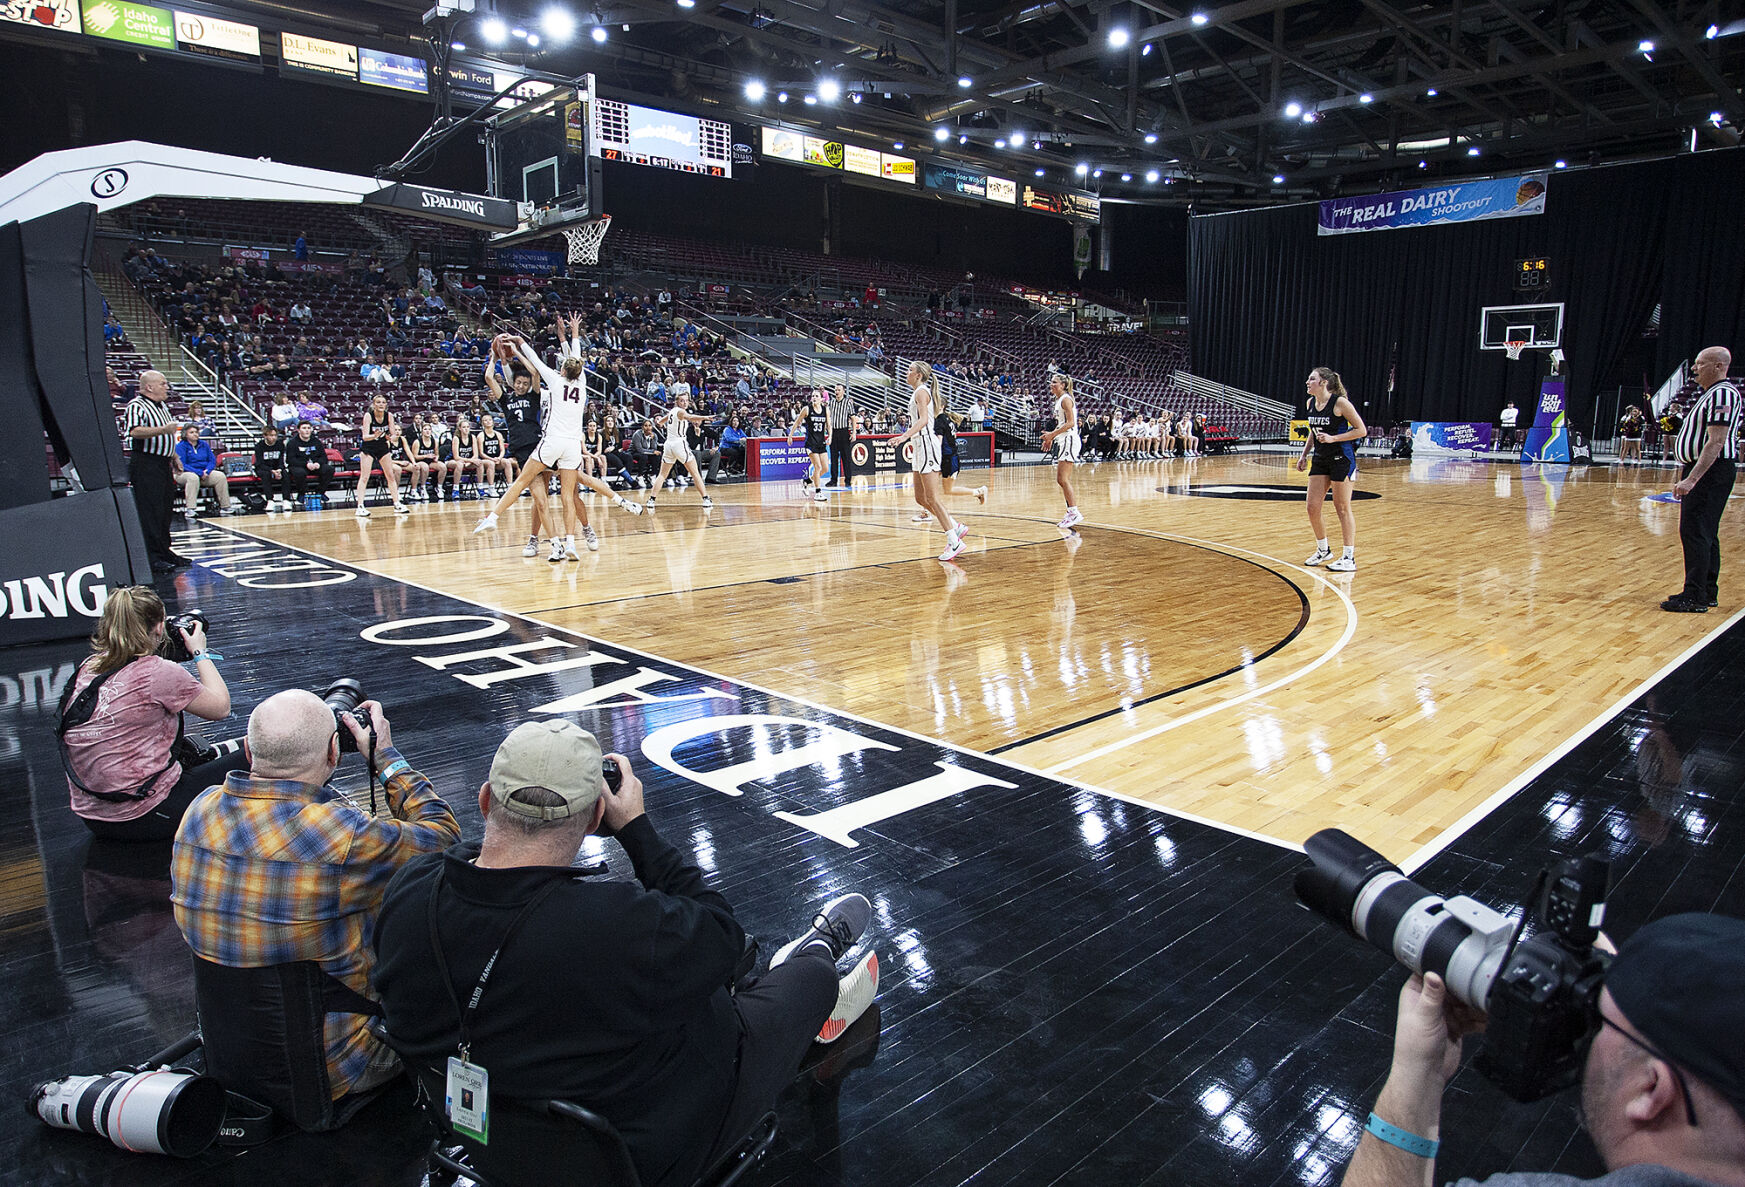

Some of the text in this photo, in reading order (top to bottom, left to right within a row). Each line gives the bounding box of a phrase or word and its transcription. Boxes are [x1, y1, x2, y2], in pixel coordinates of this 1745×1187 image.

[123, 8, 158, 24] Idaho
[124, 19, 171, 36] Central
[307, 42, 337, 56] Evans
[471, 73, 492, 86] Ford
[605, 149, 618, 160] 27
[711, 166, 722, 177] 21
[421, 191, 486, 217] SPALDING
[1333, 187, 1462, 224] THE REAL DAIRY
[1431, 196, 1493, 217] SHOOTOUT
[563, 384, 580, 404] 14
[514, 409, 524, 422] 3
[813, 422, 823, 432] 33
[360, 616, 1020, 849] IDAHO
[468, 986, 483, 1009] IDAHO
